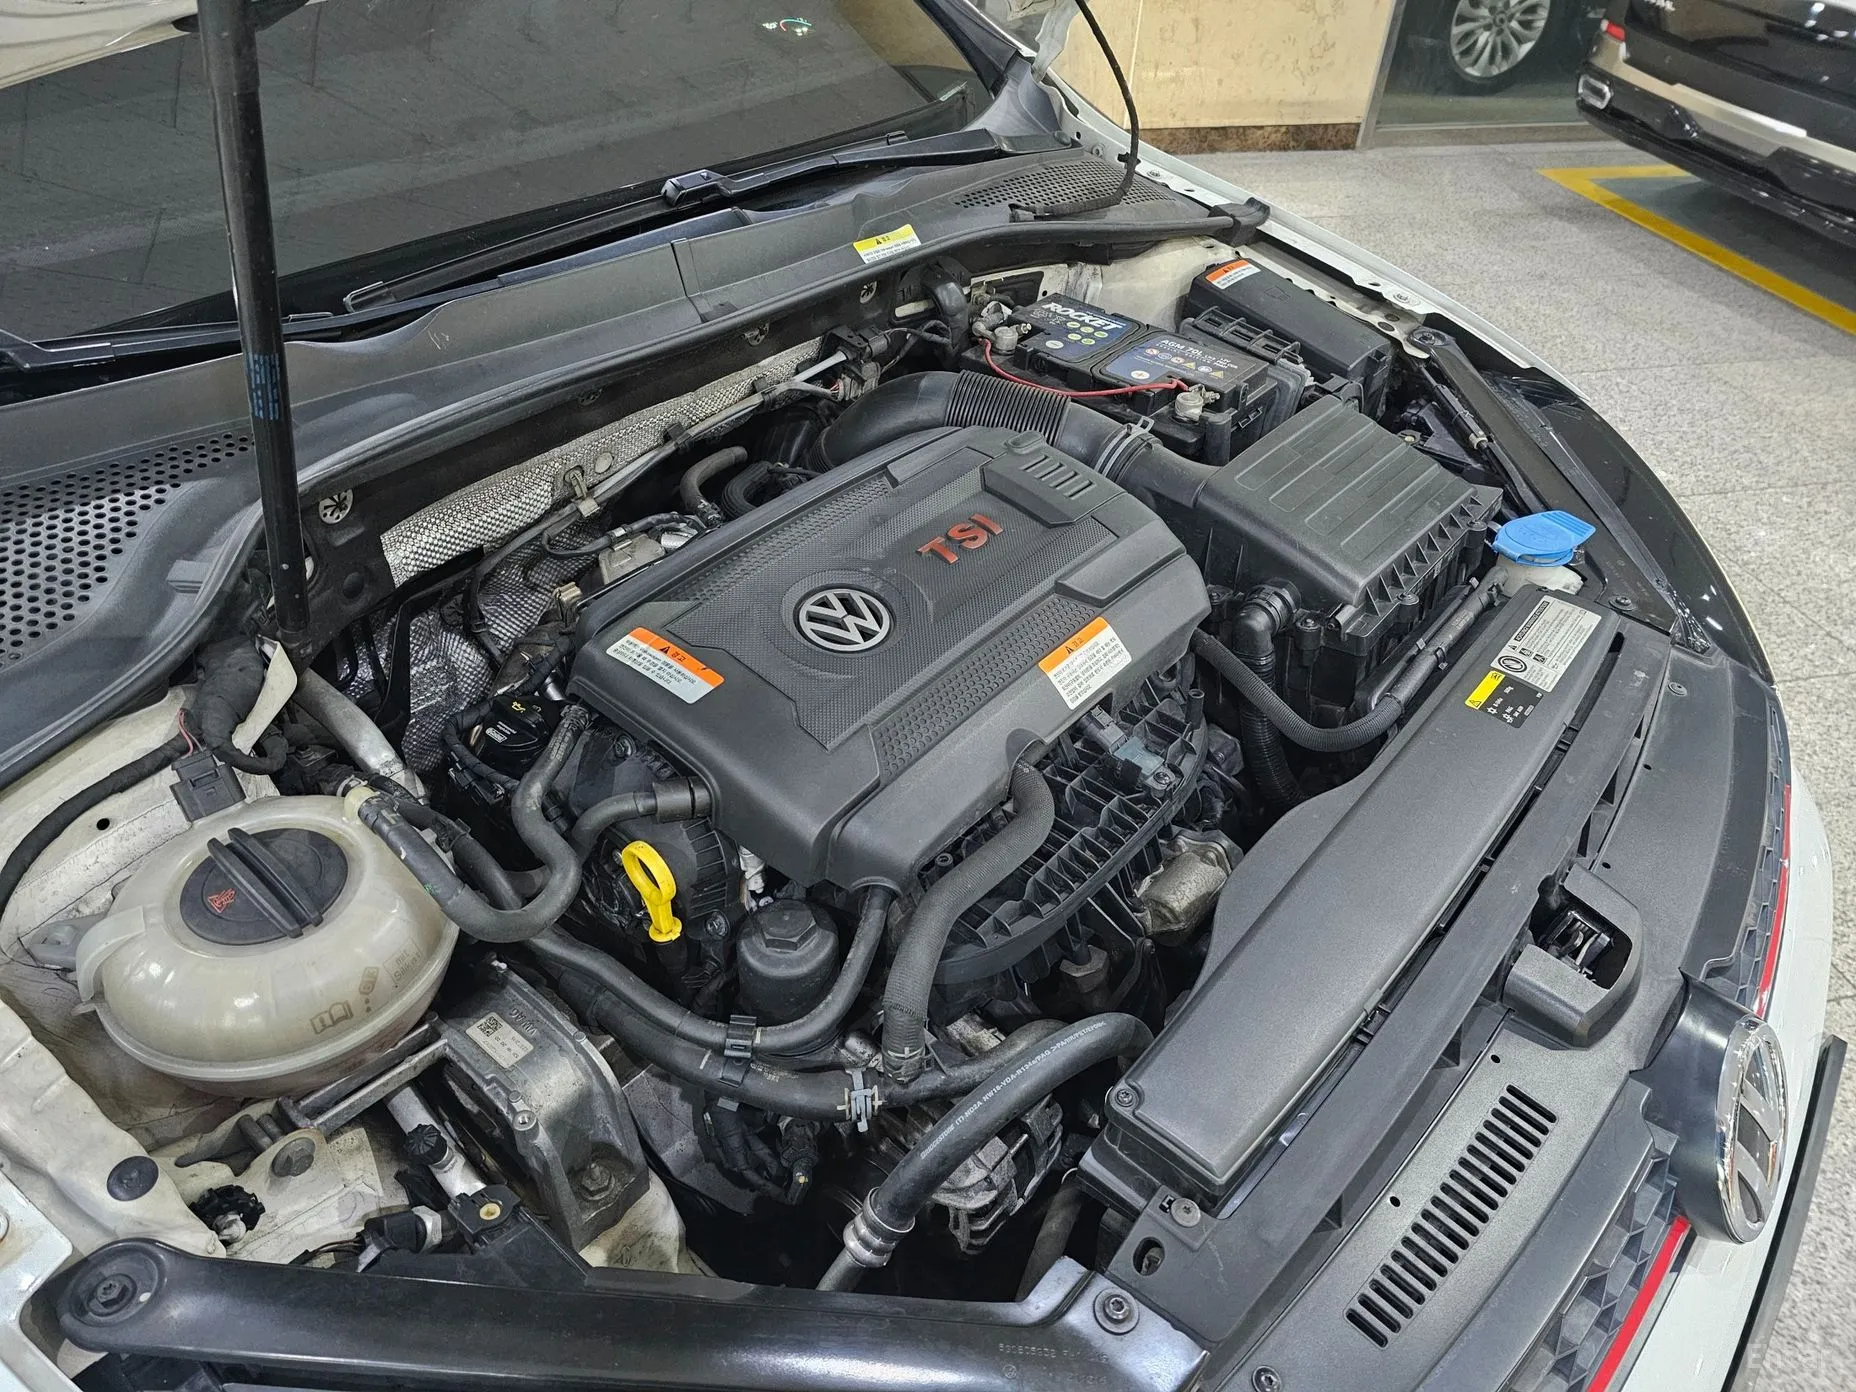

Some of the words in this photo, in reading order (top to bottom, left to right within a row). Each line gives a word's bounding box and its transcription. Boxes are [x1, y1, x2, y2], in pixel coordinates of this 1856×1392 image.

[1042, 302, 1122, 330] ROCKET
[1161, 340, 1186, 350] AGM
[1187, 346, 1204, 356] 70L
[917, 513, 1004, 564] TSI
